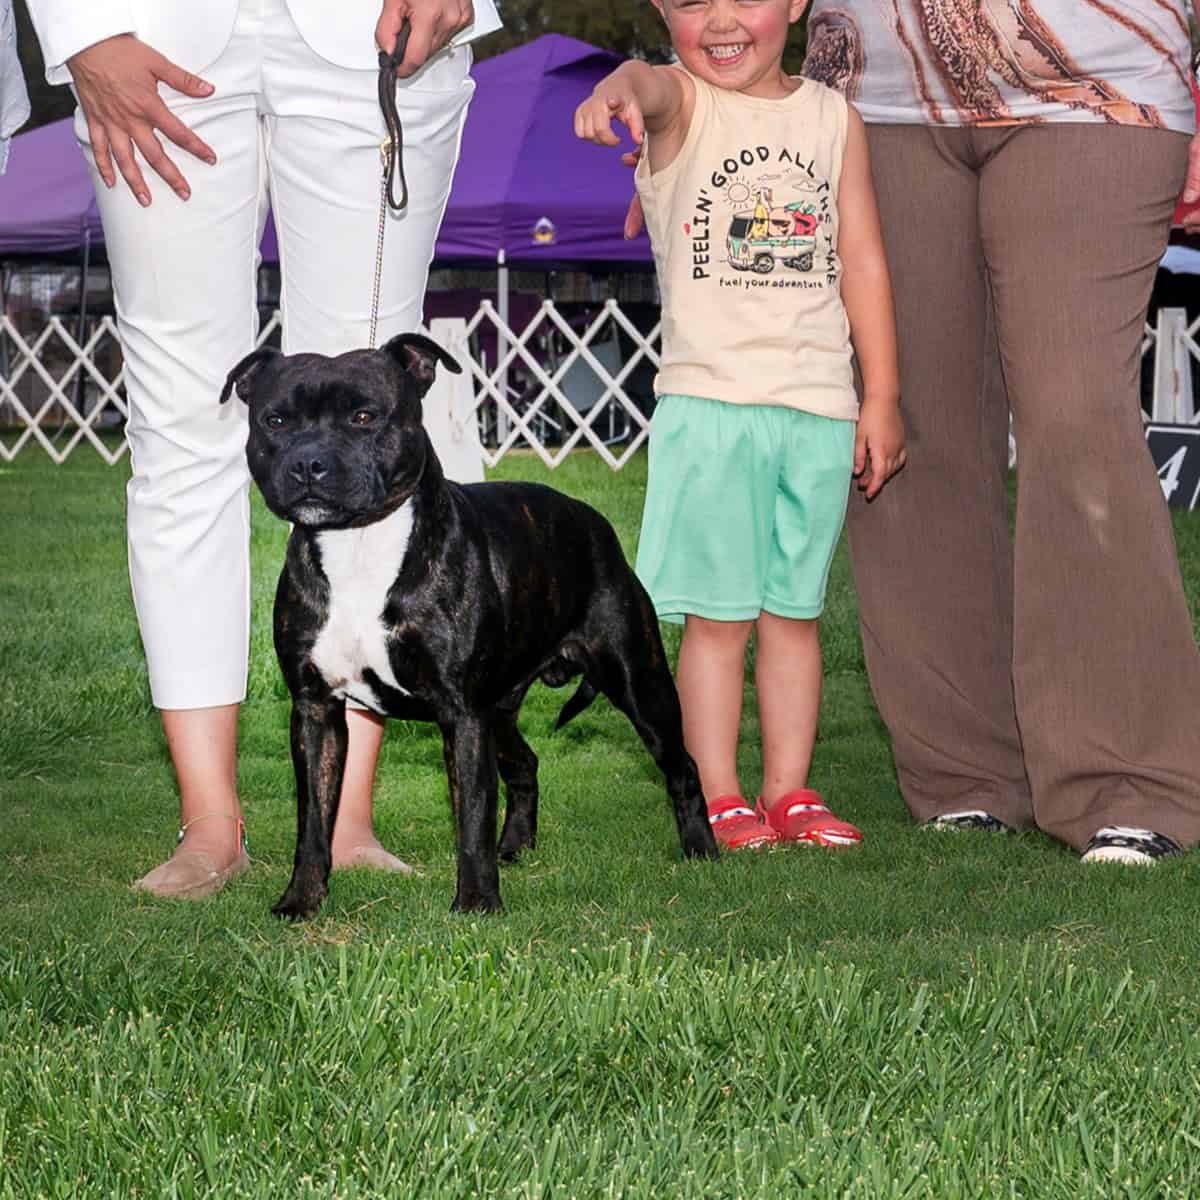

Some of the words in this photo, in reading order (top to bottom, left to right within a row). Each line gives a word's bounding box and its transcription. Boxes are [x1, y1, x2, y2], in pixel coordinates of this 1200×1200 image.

[711, 146, 770, 187] GOOD
[778, 148, 815, 178] ALL
[719, 277, 742, 287] fuel
[744, 279, 769, 289] your
[771, 278, 823, 289] adventure
